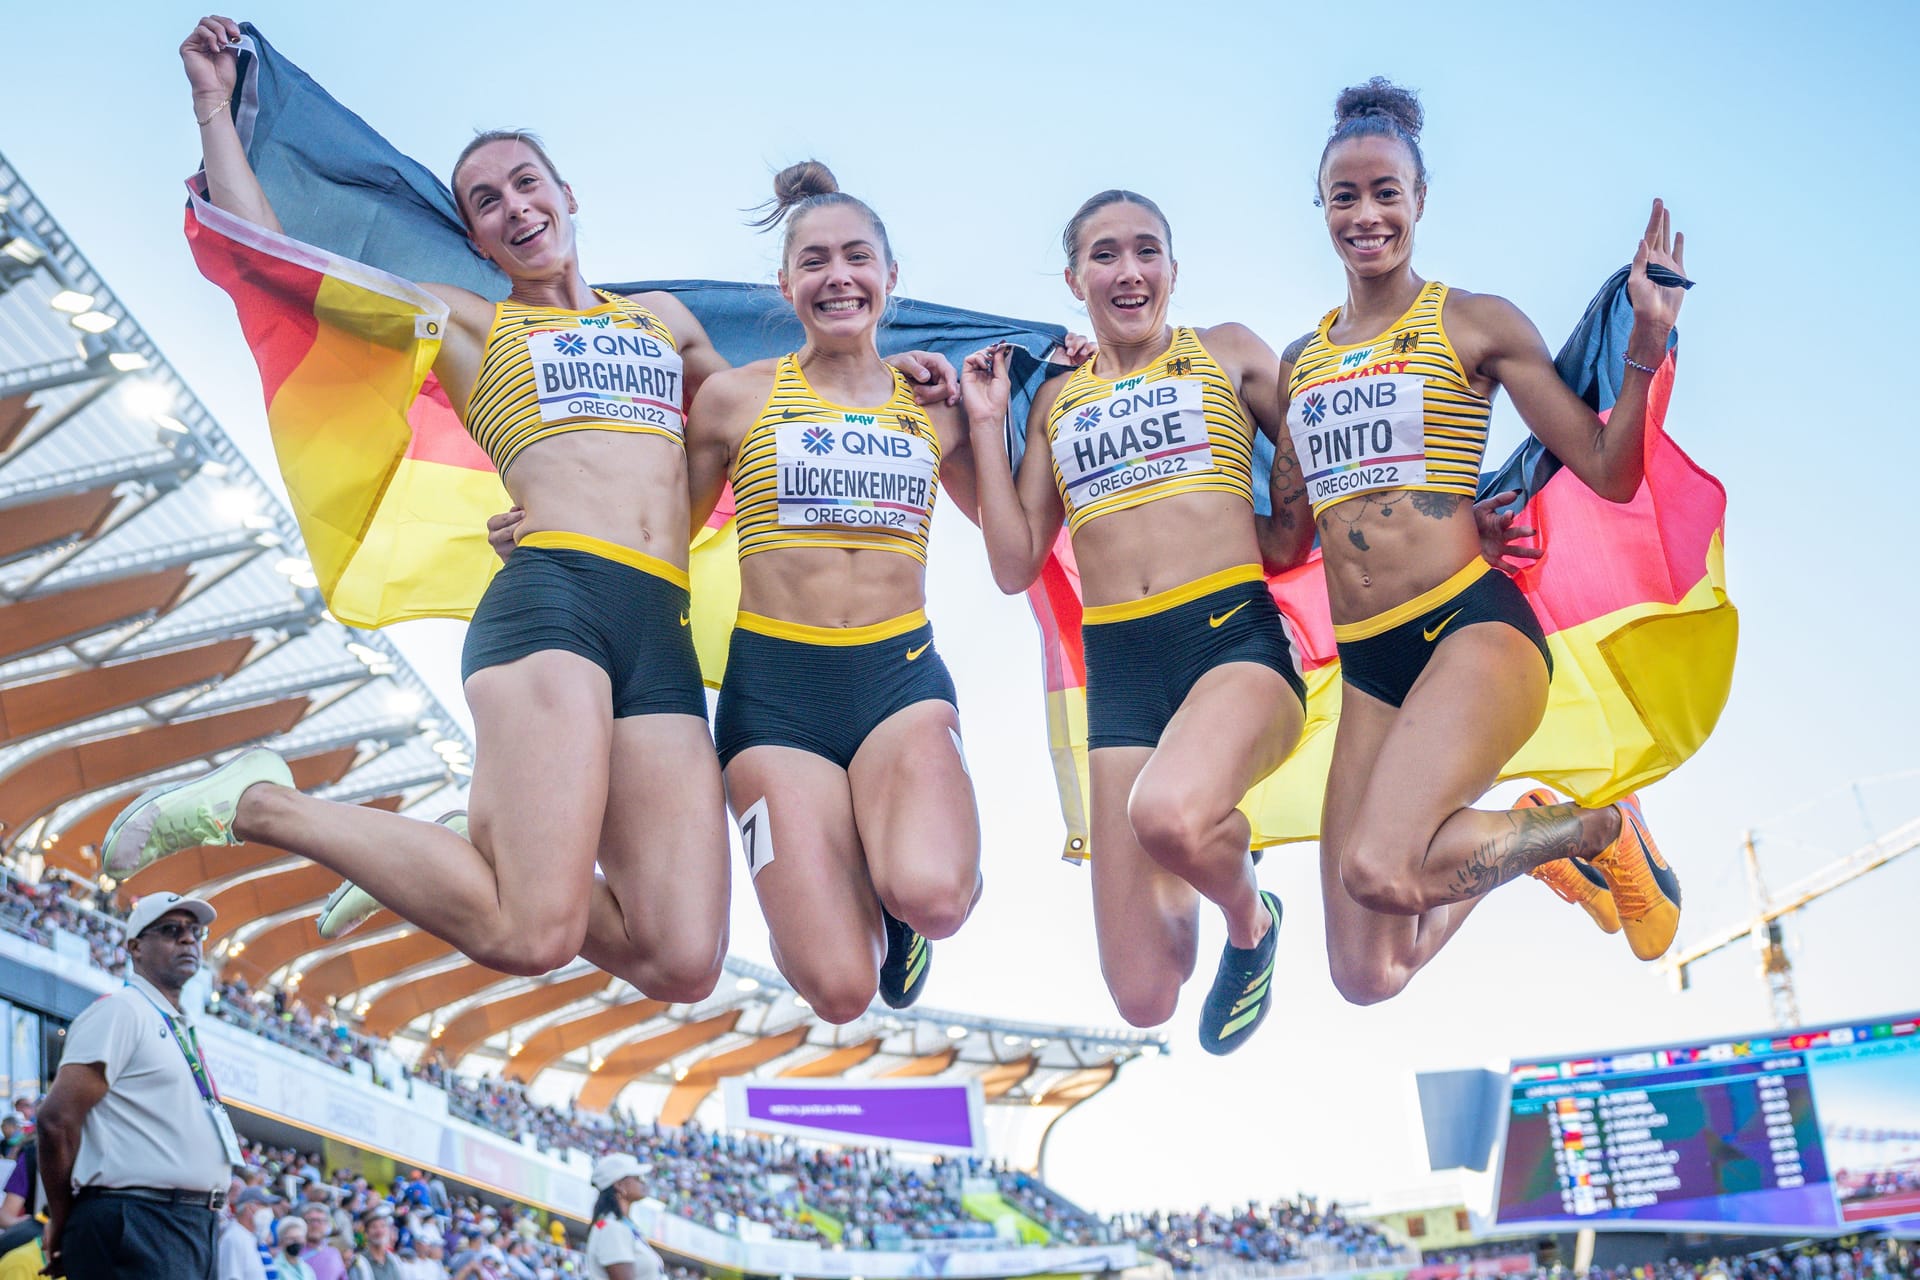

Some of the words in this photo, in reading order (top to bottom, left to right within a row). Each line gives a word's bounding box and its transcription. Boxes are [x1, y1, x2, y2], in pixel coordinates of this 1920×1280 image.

[593, 335, 662, 358] QNB
[542, 361, 678, 402] BURGHARDT
[568, 400, 666, 425] OREGON22
[1109, 386, 1178, 419] QNB
[1332, 382, 1397, 416] QNB
[841, 431, 912, 458] QNB
[1073, 410, 1186, 473] HAASE
[1308, 419, 1393, 469] PINTO
[784, 461, 927, 507] LÜCKENKEMPER
[1088, 457, 1188, 498] OREGON22
[1316, 466, 1399, 498] OREGON22
[804, 507, 906, 528] OREGON22
